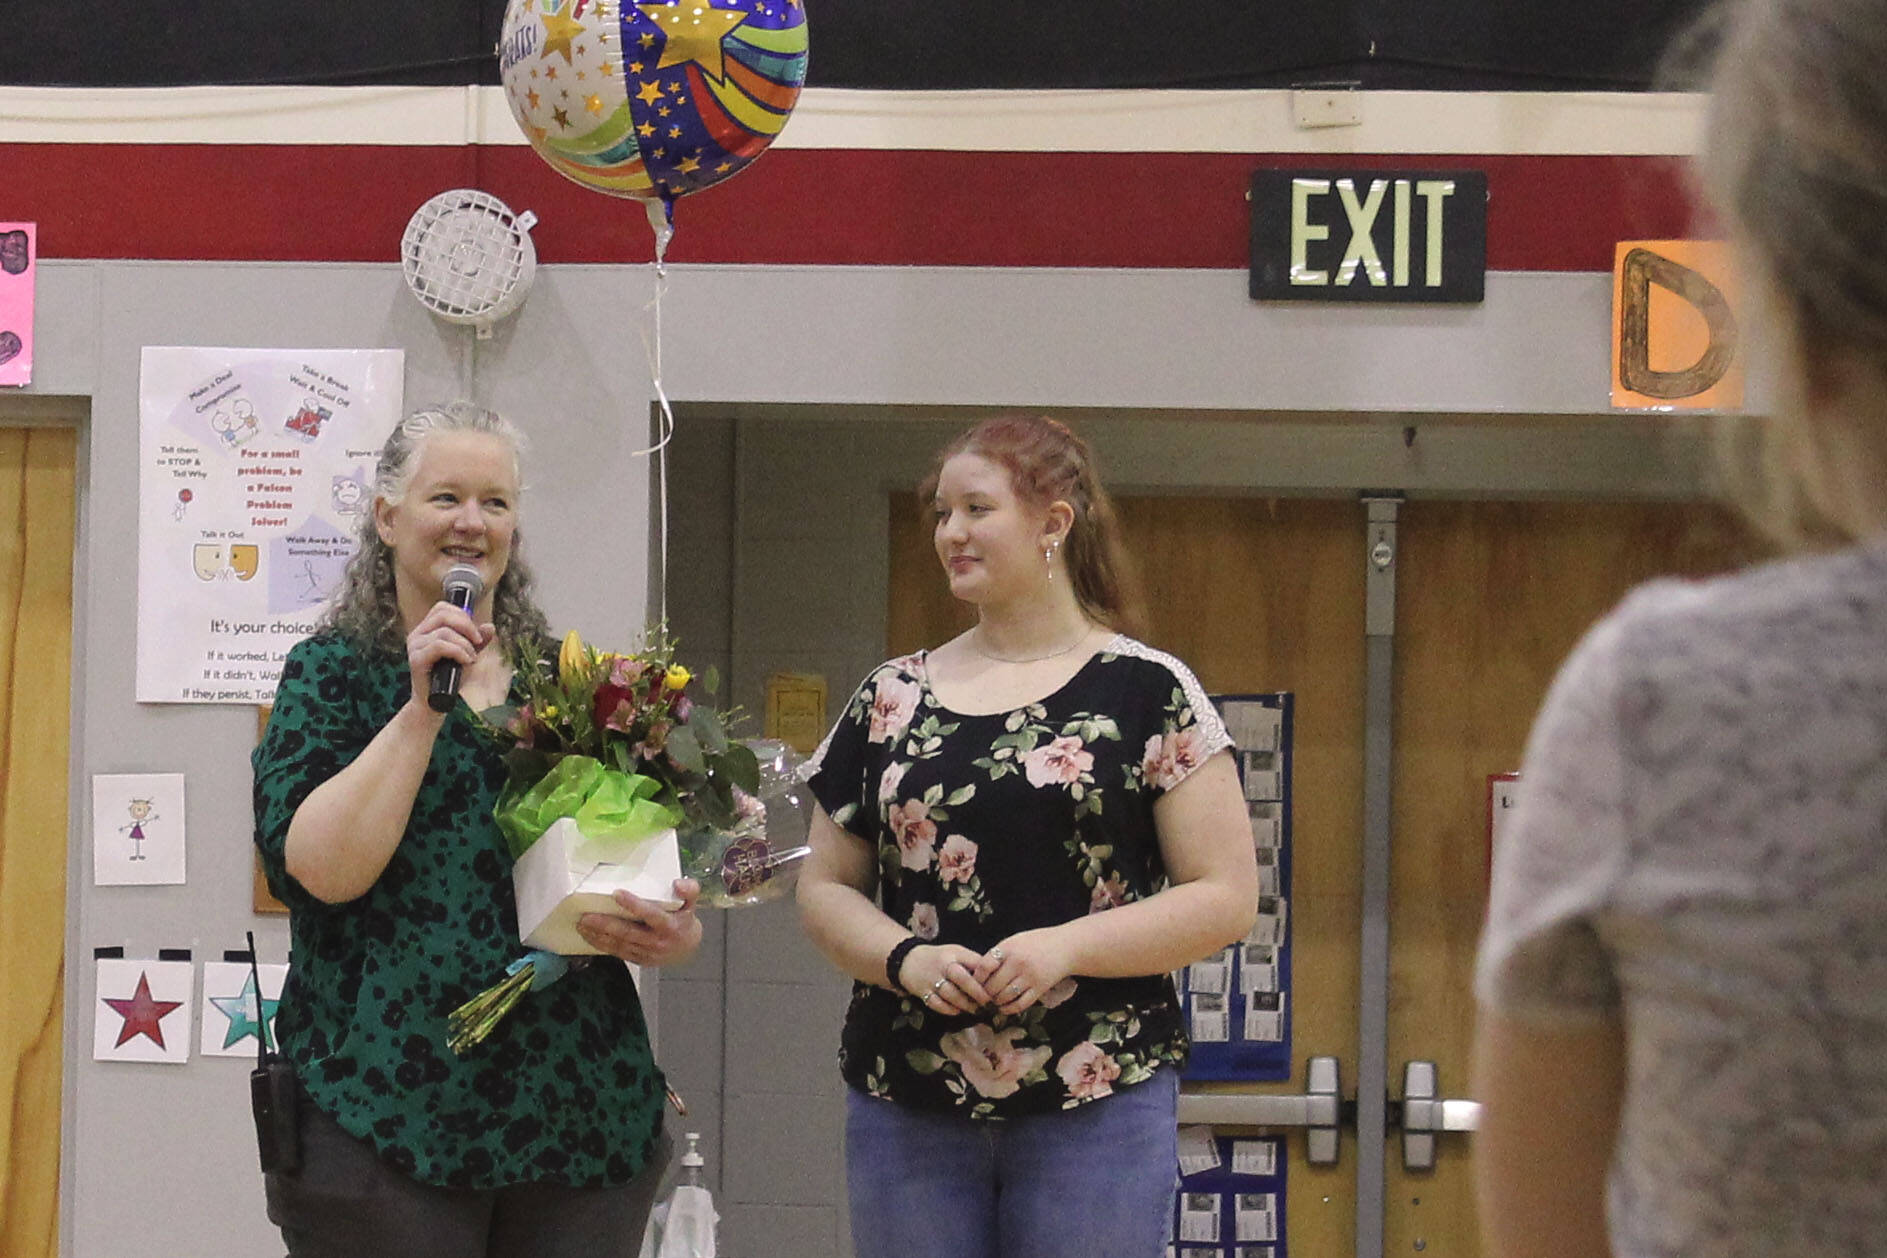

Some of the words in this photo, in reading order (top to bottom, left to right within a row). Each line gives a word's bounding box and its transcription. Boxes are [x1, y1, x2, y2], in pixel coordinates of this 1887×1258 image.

[1290, 178, 1456, 287] EXIT
[1619, 247, 1738, 400] D
[302, 364, 319, 378] Take
[326, 377, 349, 391] Break
[189, 387, 209, 400] Make
[215, 370, 233, 384] Deal
[290, 374, 308, 388] Wait
[317, 388, 336, 402] Cool
[336, 397, 350, 408] Off
[195, 384, 241, 413] Compromise
[241, 450, 257, 458] For
[271, 450, 300, 458] small
[345, 449, 371, 458] Ignore
[188, 471, 207, 480] Why
[238, 467, 287, 476] problem,
[289, 467, 302, 475] be
[257, 484, 292, 492] Falcon
[247, 501, 292, 509] Problem
[252, 517, 287, 526] Solver!
[308, 537, 329, 545] Away
[288, 549, 331, 557] Something
[210, 619, 229, 633] It's
[233, 624, 266, 636] your
[207, 651, 215, 660] If
[217, 652, 224, 660] it
[227, 651, 269, 662] worked,
[272, 650, 286, 661] Le
[203, 670, 211, 679] If
[213, 670, 220, 679] it
[223, 670, 256, 681] didn't,
[259, 670, 281, 680] Wal
[182, 688, 190, 698] If
[192, 688, 216, 700] they
[218, 689, 252, 700] persist,
